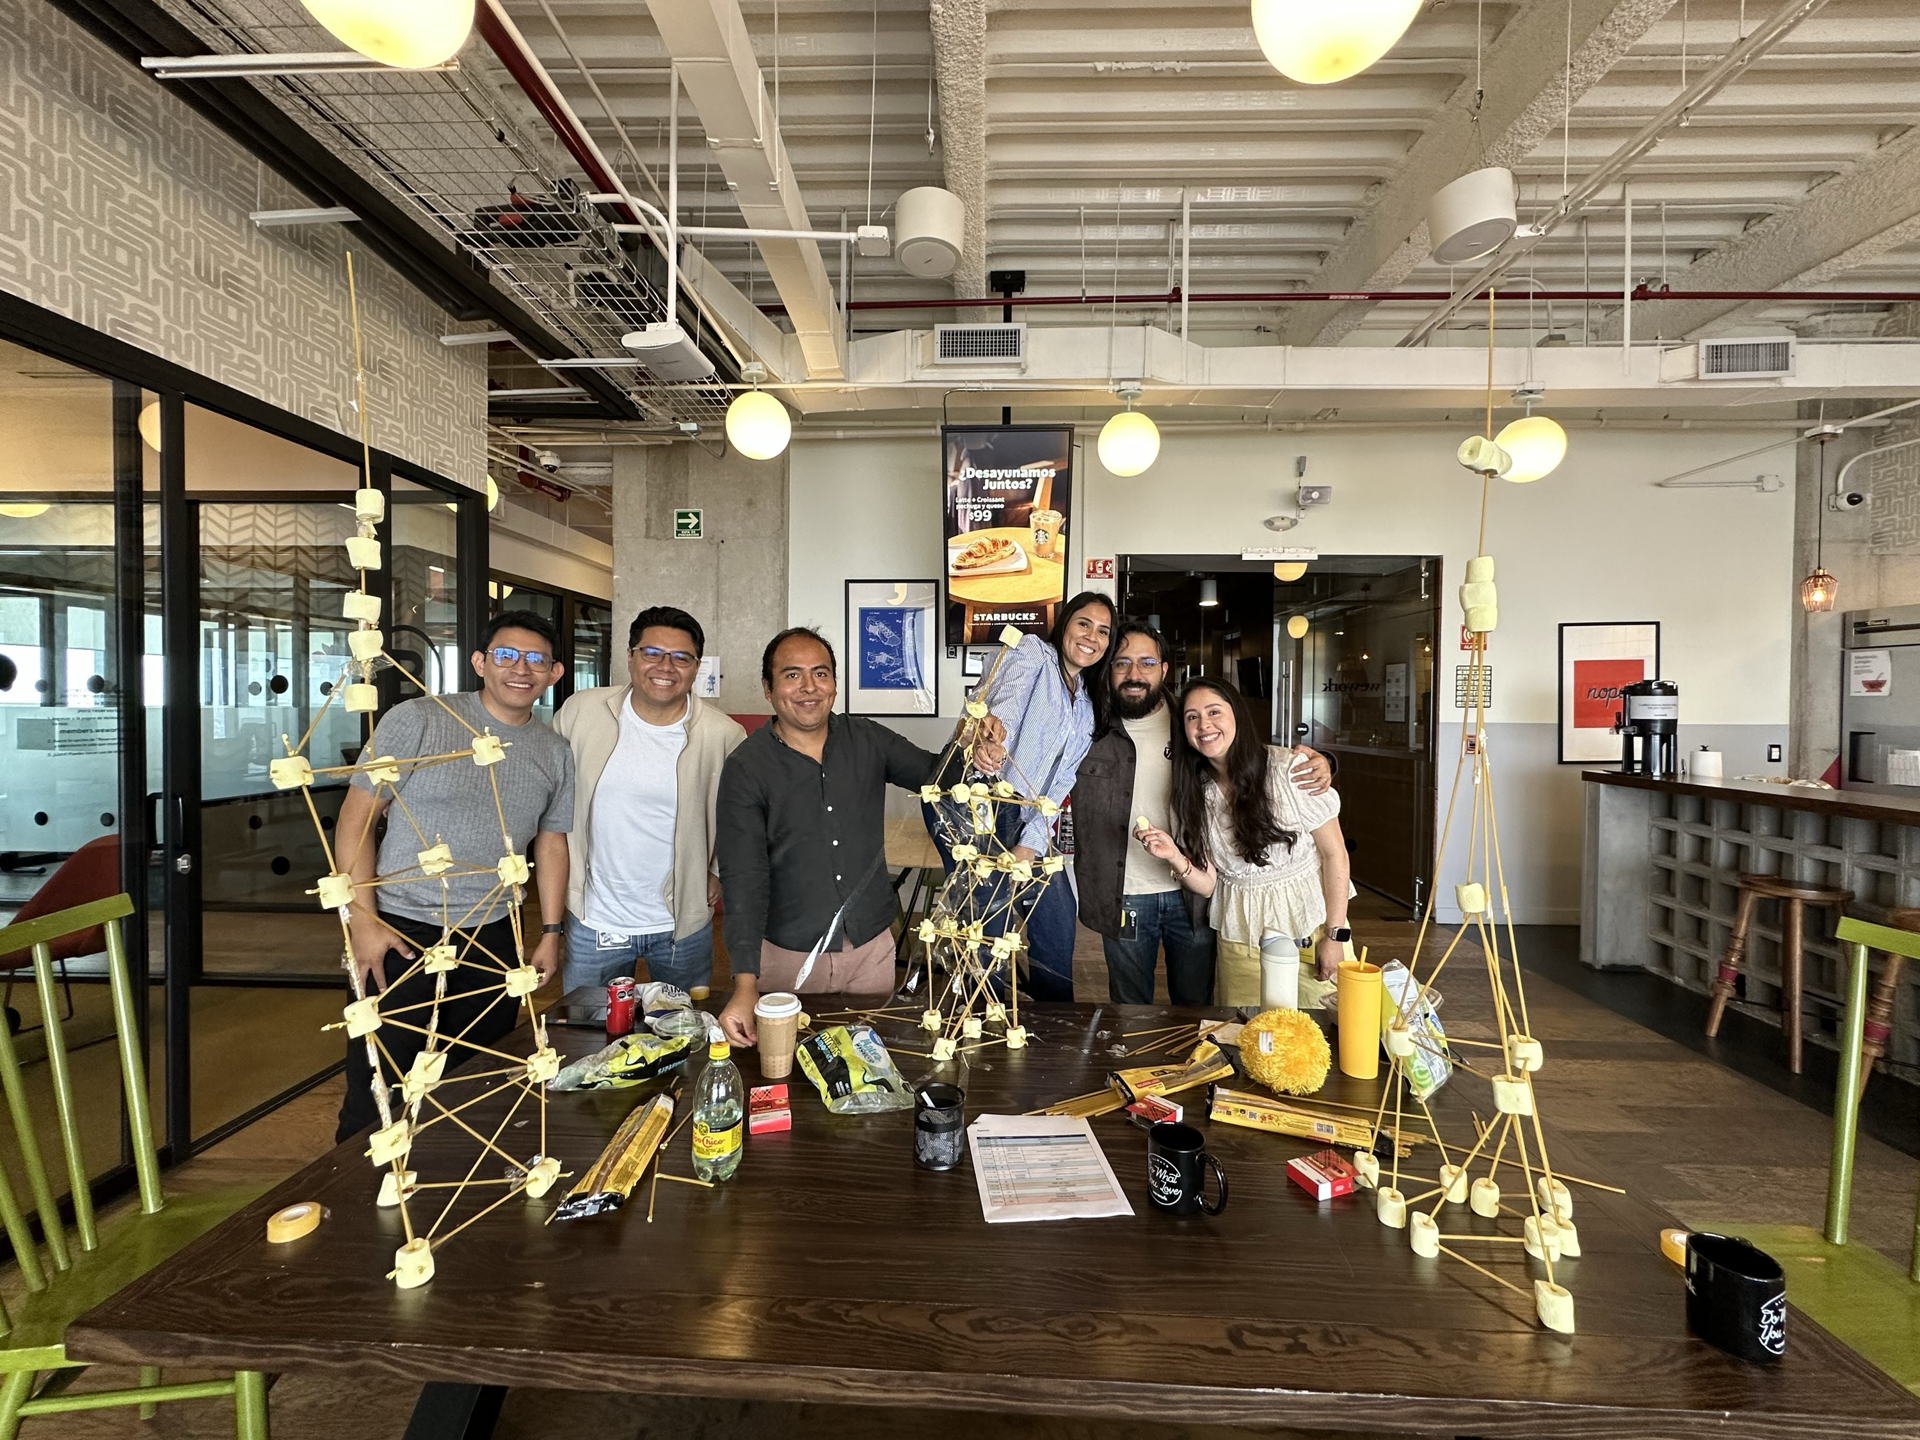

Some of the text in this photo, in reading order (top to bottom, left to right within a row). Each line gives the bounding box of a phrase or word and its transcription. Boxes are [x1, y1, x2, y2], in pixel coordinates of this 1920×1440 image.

[960, 467, 1056, 480] ¿Desayunamos
[982, 478, 1033, 490] Juntos?
[968, 510, 992, 522] $99
[973, 613, 1037, 621] STARBUCKS
[702, 1136, 725, 1148] Chico
[1154, 1165, 1178, 1184] What
[1761, 1309, 1779, 1324] Do
[1758, 1323, 1782, 1345] You
